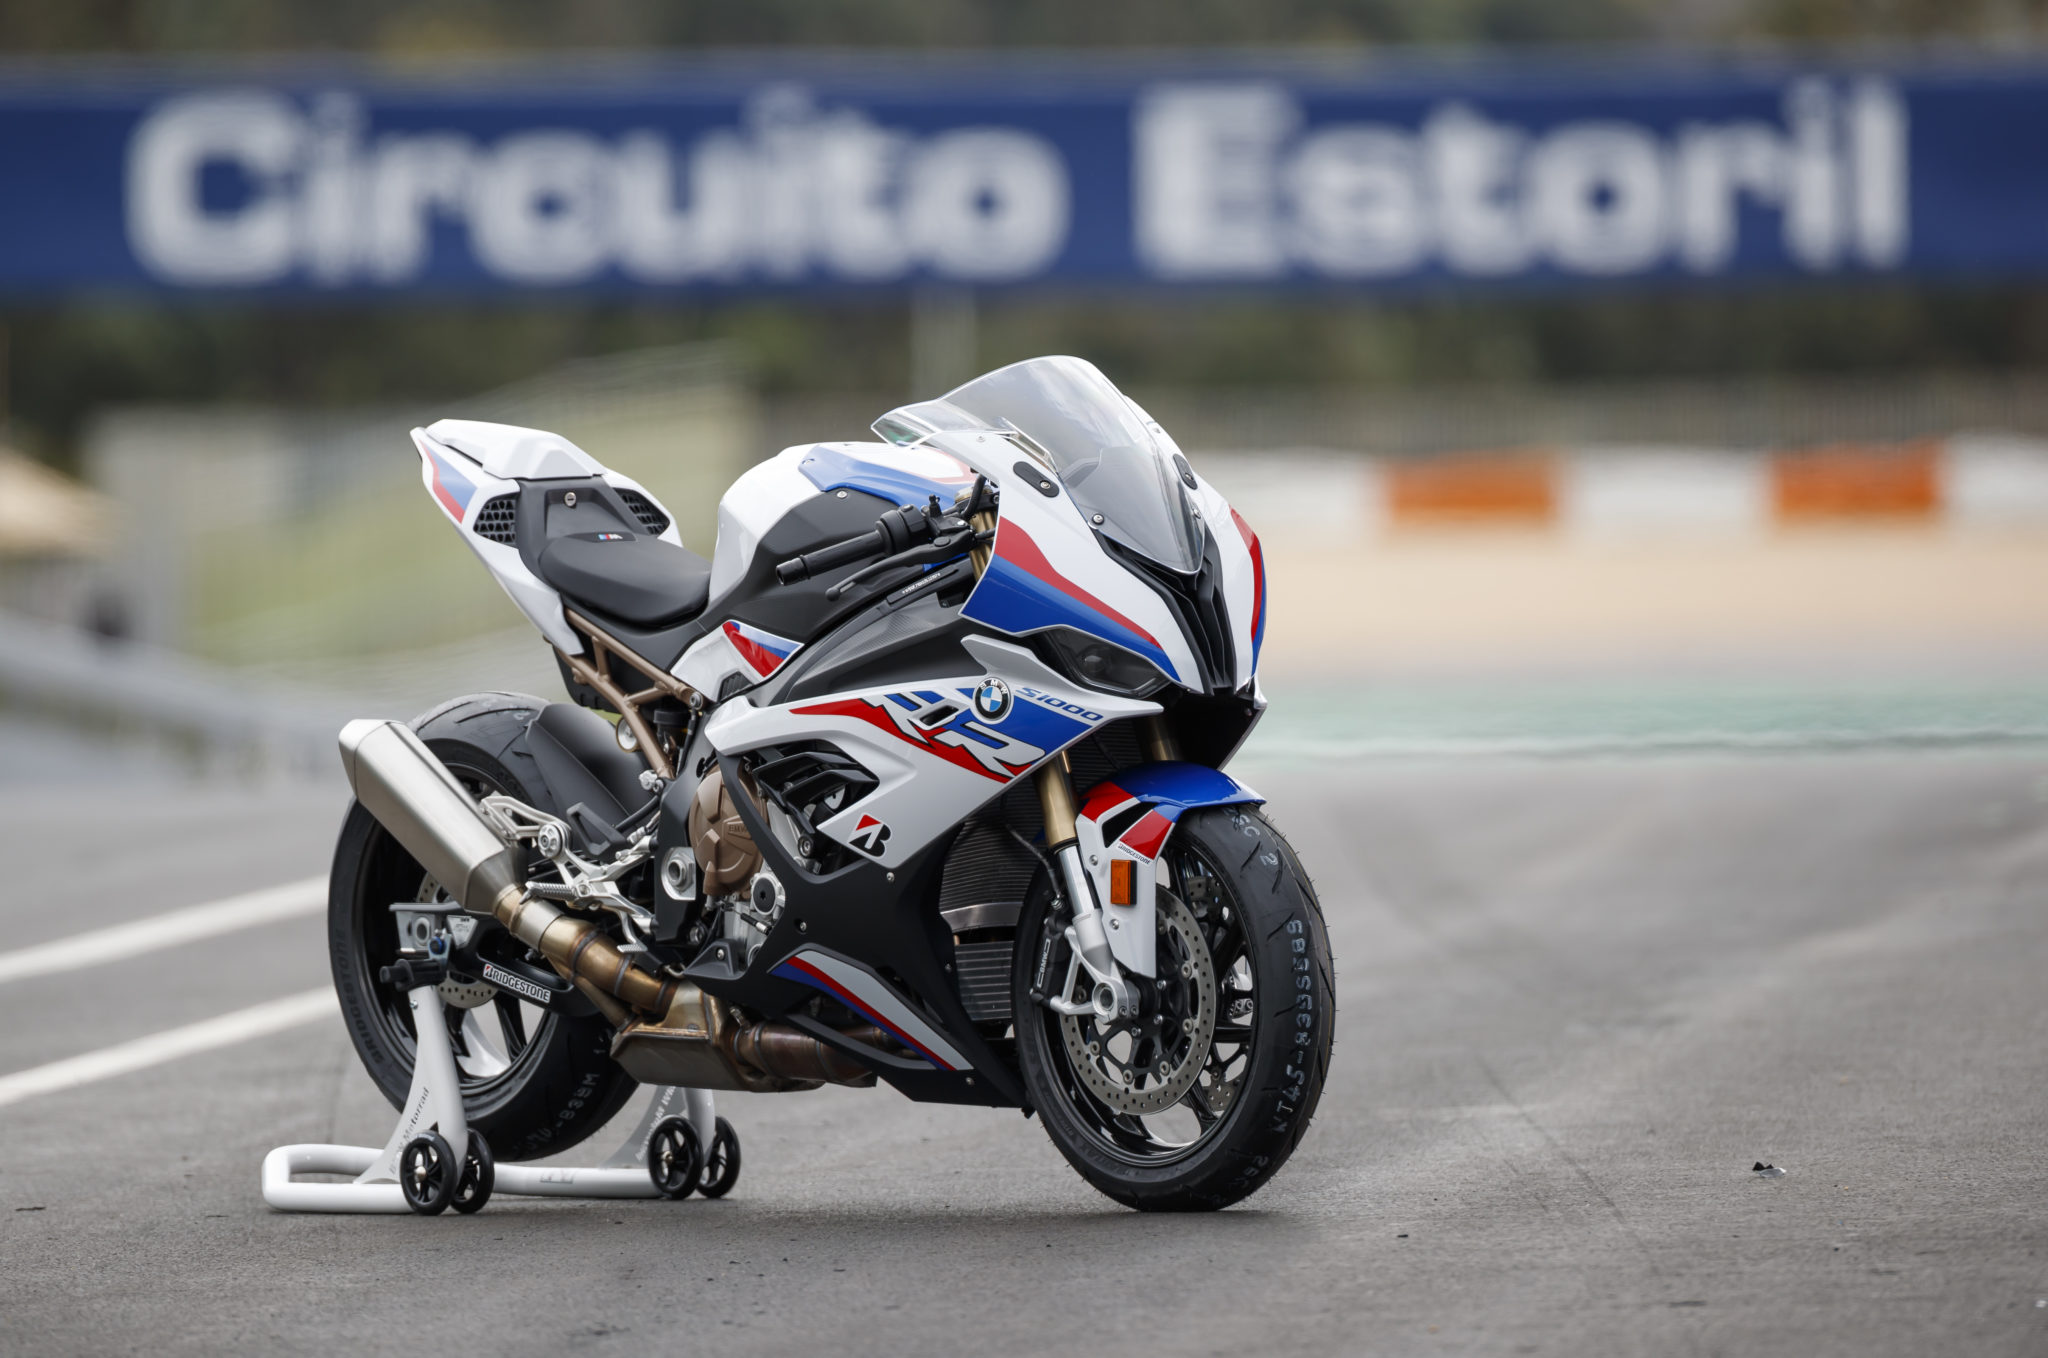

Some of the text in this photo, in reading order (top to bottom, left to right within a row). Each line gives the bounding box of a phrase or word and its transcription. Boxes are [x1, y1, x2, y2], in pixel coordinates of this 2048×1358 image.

[124, 76, 1908, 286] Circuito Estoril
[1015, 687, 1104, 722] S1000
[484, 964, 551, 1001] BRIDGESTONE
